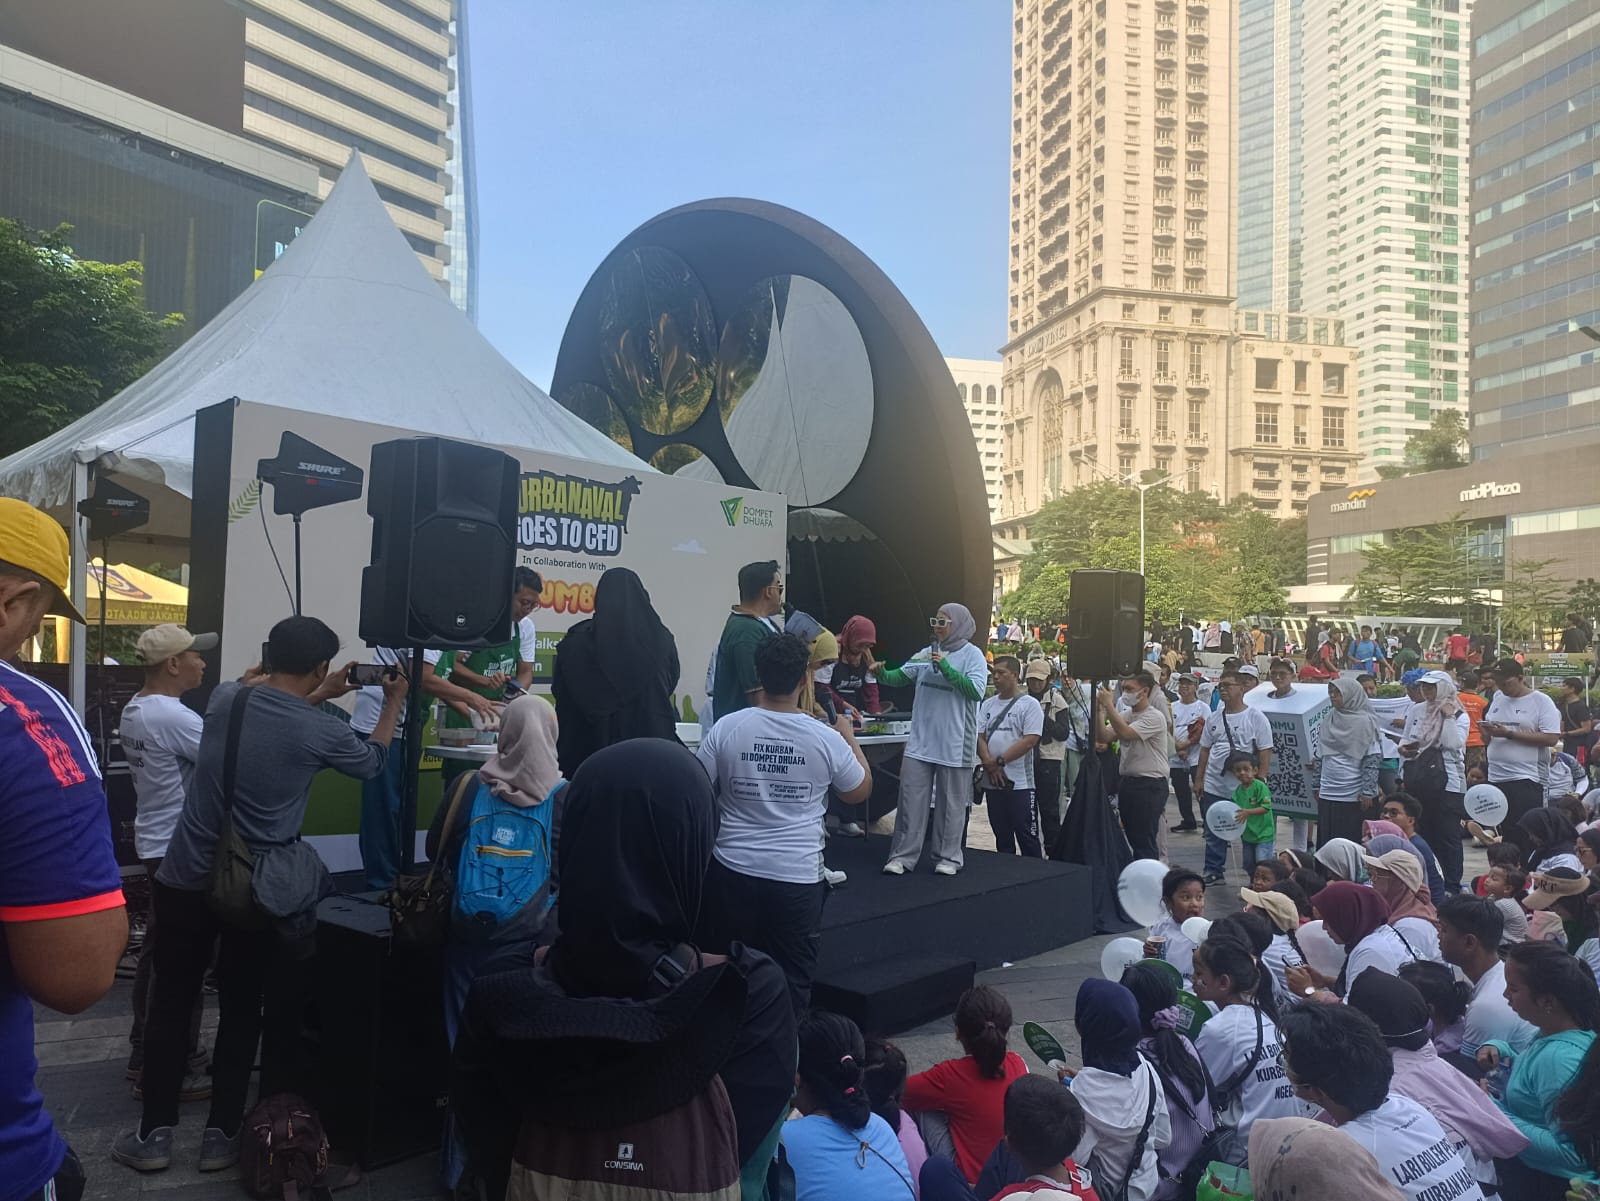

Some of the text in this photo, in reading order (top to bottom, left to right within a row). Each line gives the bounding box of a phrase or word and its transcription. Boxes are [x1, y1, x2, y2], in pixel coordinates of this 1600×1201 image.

[298, 461, 342, 475] SHURE
[1459, 481, 1521, 502] midPlaza
[743, 506, 774, 518] DOMPET
[743, 515, 774, 528] DHUAFA
[517, 514, 619, 552] OES TO CFD
[522, 555, 607, 571] In Collaboration With
[538, 579, 595, 614] UMB
[535, 637, 562, 650] alks
[753, 743, 794, 755] FIX KURBAN
[741, 752, 806, 766] DI DOMPET DHUAFA
[757, 763, 789, 775] GA ZONK!
[1296, 800, 1311, 809] ITU
[1256, 1065, 1288, 1082] KURB
[604, 1160, 644, 1172] CONSINA
[1391, 1156, 1425, 1186] LARI
[1416, 1143, 1450, 1173] BOLEH
